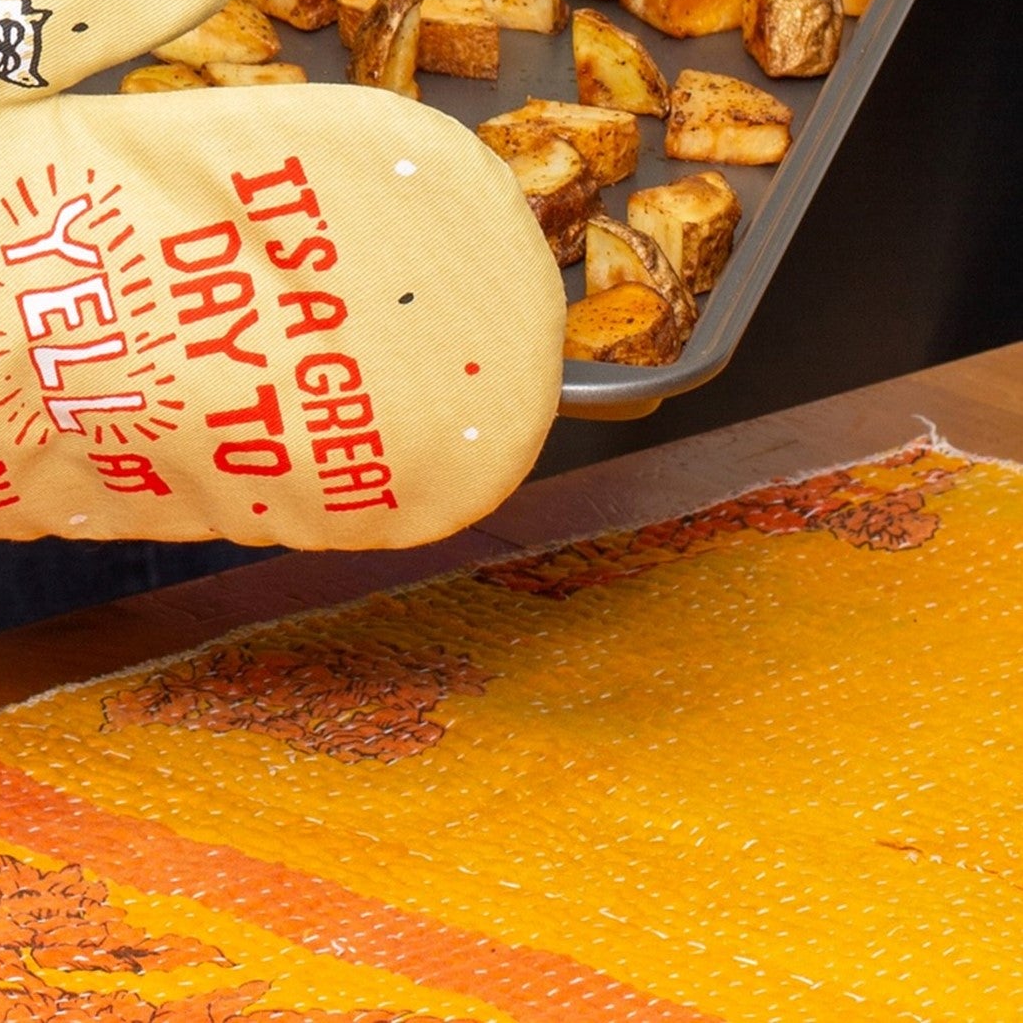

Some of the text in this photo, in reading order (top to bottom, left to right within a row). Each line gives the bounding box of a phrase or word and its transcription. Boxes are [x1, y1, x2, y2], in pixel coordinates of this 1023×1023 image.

[0, 193, 173, 496] YELL AT
[159, 220, 293, 478] DAY TO
[230, 155, 399, 512] IT'S A GREAT
